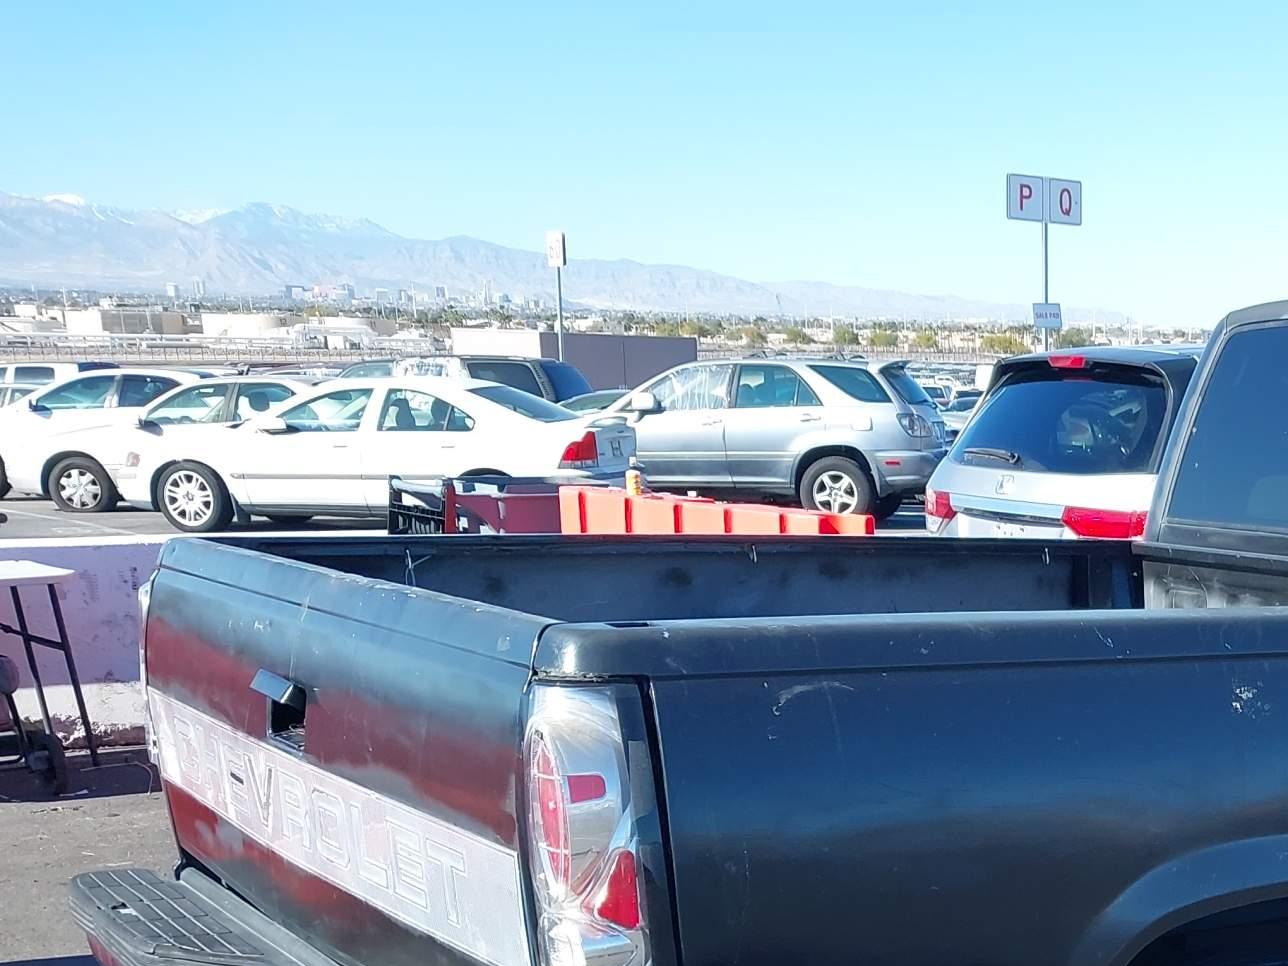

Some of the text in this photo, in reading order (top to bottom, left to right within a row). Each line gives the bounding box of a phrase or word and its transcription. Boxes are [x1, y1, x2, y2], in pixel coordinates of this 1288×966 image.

[1019, 183, 1032, 211] P
[1060, 188, 1072, 216] Q
[173, 715, 468, 928] CHEVROLET
